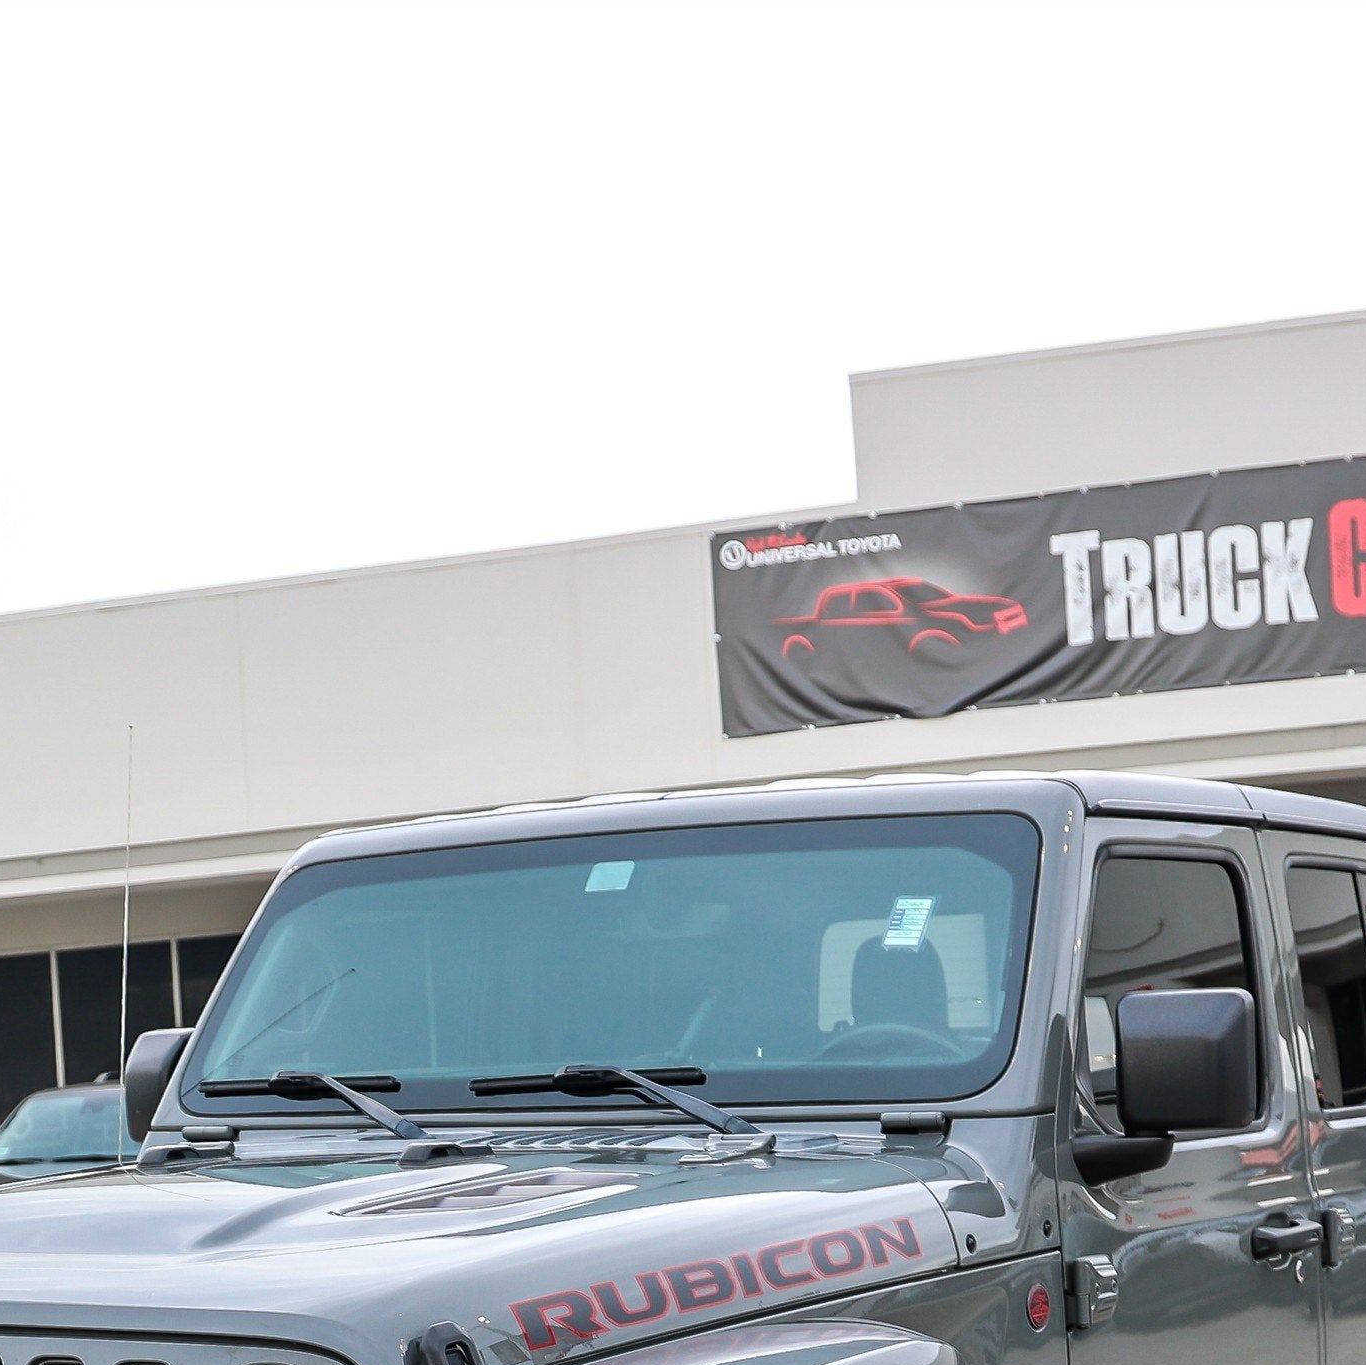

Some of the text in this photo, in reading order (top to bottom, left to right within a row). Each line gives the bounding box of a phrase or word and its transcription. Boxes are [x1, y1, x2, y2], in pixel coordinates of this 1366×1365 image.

[745, 541, 838, 568] UNIVERSAL
[837, 533, 902, 556] TOYOTA
[1049, 516, 1319, 647] TRUCK
[509, 1216, 924, 1351] RUBICON
